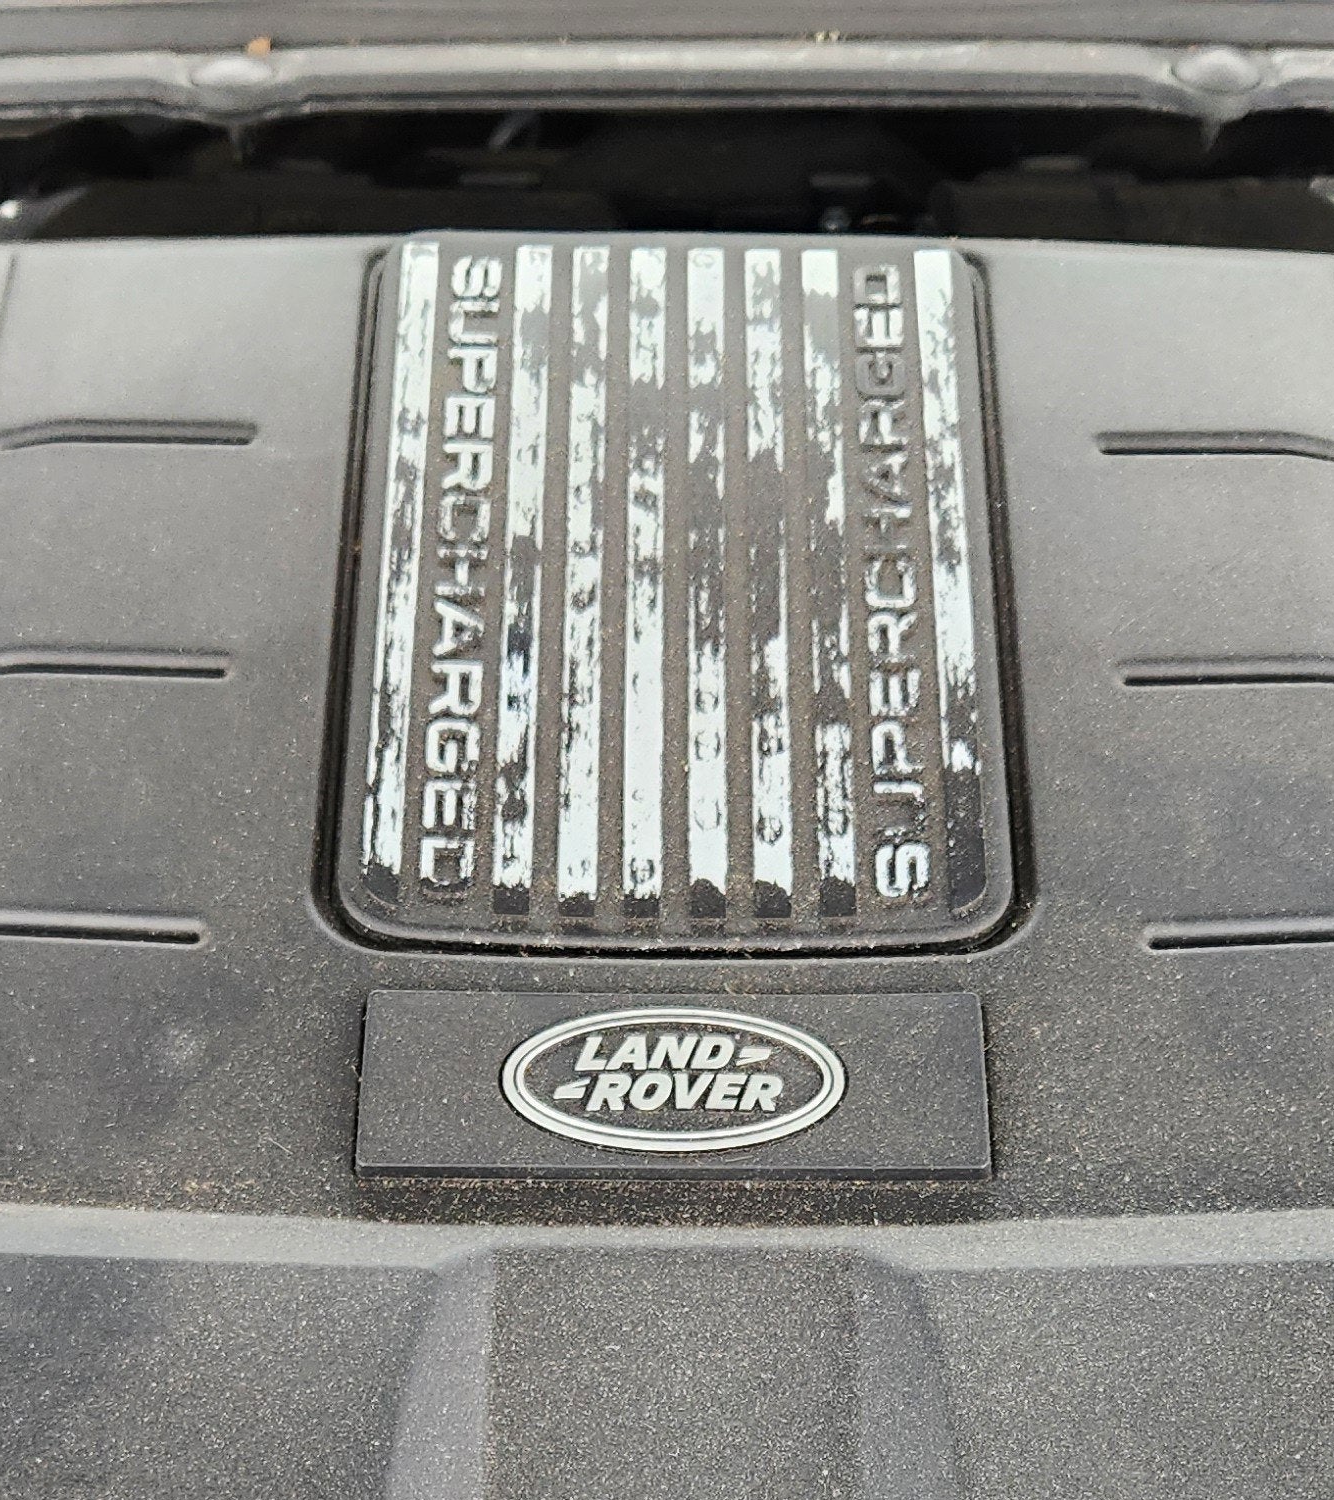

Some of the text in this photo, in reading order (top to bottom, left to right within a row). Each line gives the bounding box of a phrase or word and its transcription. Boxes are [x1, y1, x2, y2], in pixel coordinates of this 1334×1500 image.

[419, 254, 503, 893] SUPERCHARGED
[852, 264, 931, 898] SUPERCHARGED
[573, 1035, 737, 1071] LAND
[584, 1071, 784, 1113] ROVER
